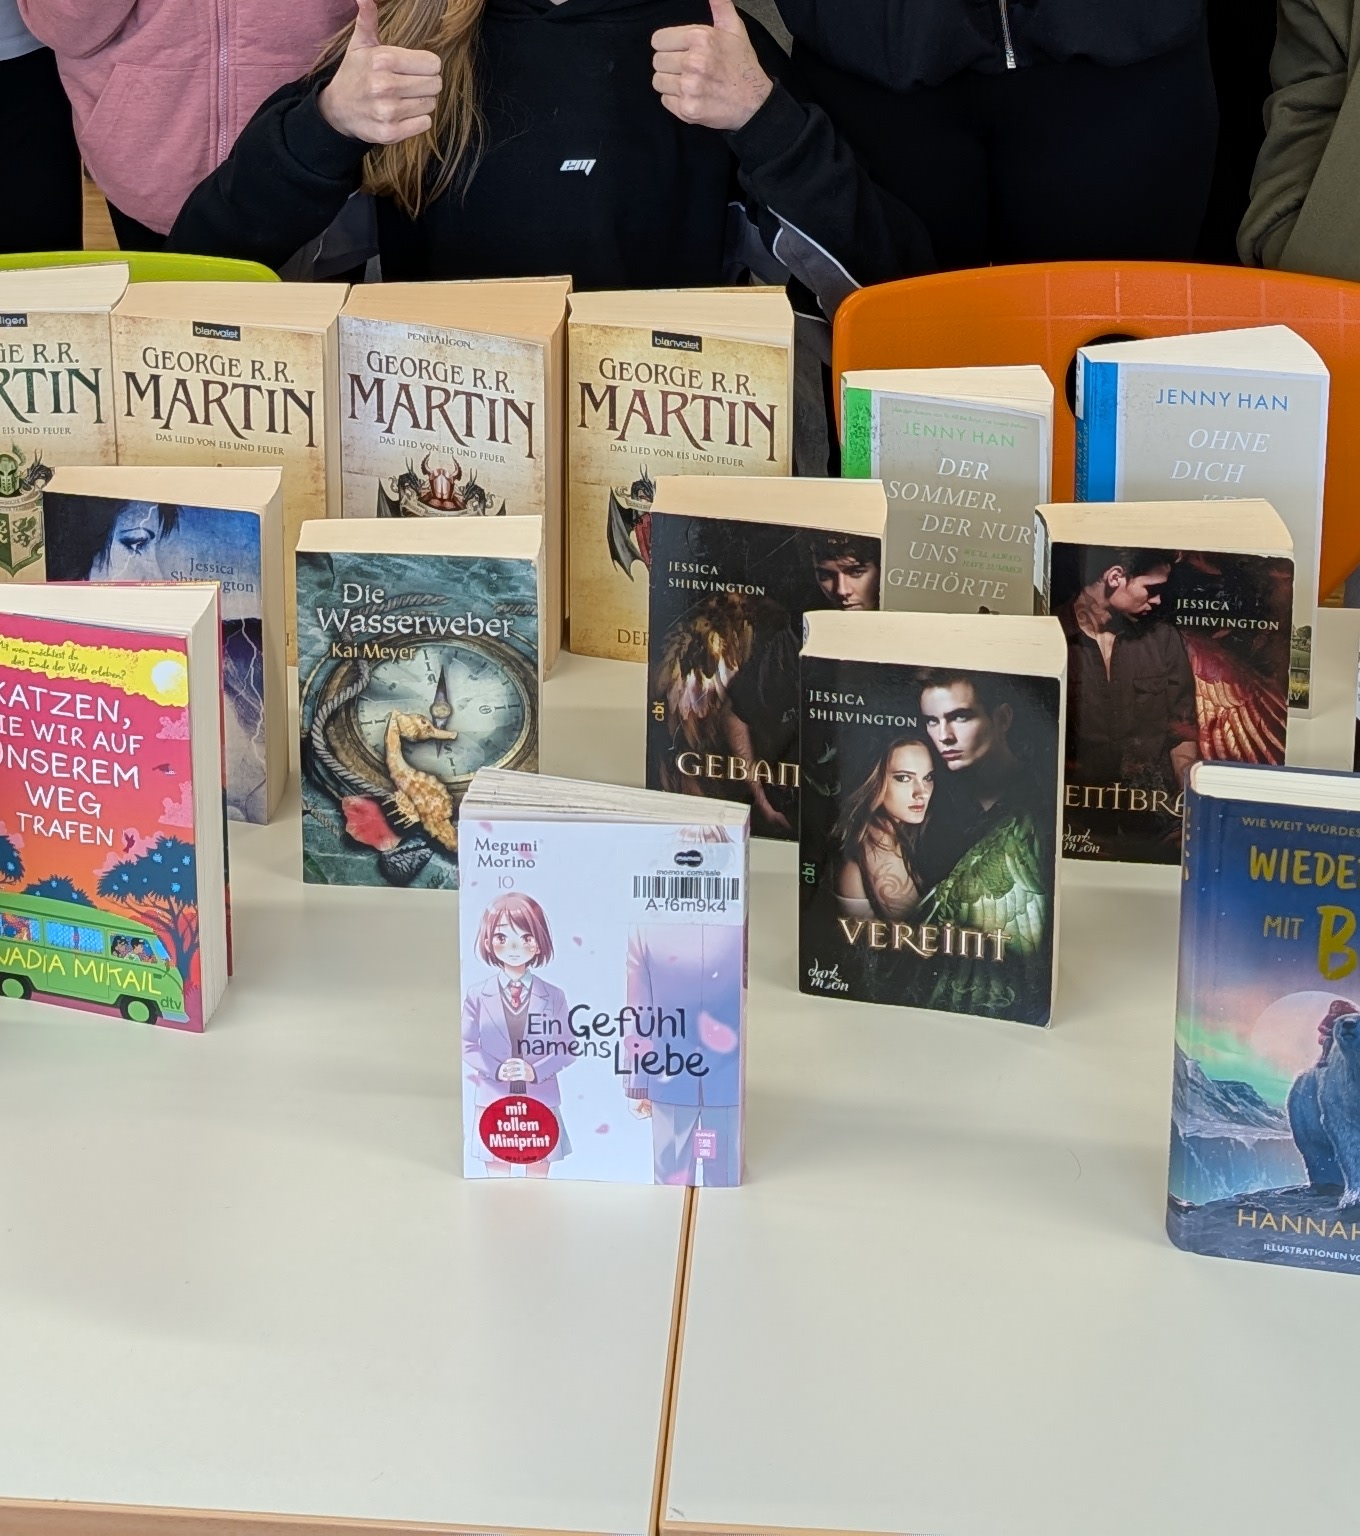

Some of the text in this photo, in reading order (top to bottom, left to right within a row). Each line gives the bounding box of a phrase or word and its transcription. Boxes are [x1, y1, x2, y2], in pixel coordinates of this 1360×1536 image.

[33, 342, 80, 364] R.R.
[142, 347, 243, 377] GEORGE
[598, 358, 757, 397] GEORGE R.R.
[122, 371, 317, 448] MARTIN
[1156, 389, 1288, 411] JENNY HAN
[347, 372, 537, 460] MARTIN
[577, 382, 779, 463] MARTIN
[155, 433, 285, 455] DAS LIED VON EIS UND FEUER
[1188, 428, 1271, 453] OHNE
[937, 458, 989, 481] DER
[1170, 460, 1246, 484] DICH
[887, 480, 1002, 514] SOMMER,
[920, 514, 1032, 545] DER NUR
[909, 541, 958, 564] UNS
[668, 561, 719, 575] JESSICA
[342, 583, 385, 604] Die
[668, 578, 766, 596] SHIRVINGTON
[887, 568, 1009, 600] GEHÖRTE
[316, 607, 515, 638] Wasserweber
[332, 642, 416, 663] Kai Meyer
[31, 719, 87, 749] WIR
[92, 734, 144, 756] AUF
[25, 780, 102, 819] WEG
[16, 811, 114, 846] TRAFEN
[1242, 816, 1268, 829] WIE
[1269, 819, 1303, 832] WEIT
[474, 837, 538, 855] Megumi
[477, 854, 536, 868] Morino
[644, 898, 727, 914] A-f6m9k4
[1263, 915, 1304, 940] MIT
[74, 958, 161, 994] MIKAIL
[160, 996, 182, 1010] dtv
[527, 1004, 687, 1040] Ein Gefühl
[517, 1038, 710, 1077] namens Liebe
[505, 1102, 527, 1116] mit
[497, 1118, 540, 1132] tollem
[489, 1134, 550, 1150] Miniprint
[1263, 1243, 1348, 1260] ILLUSTRATIONEN
